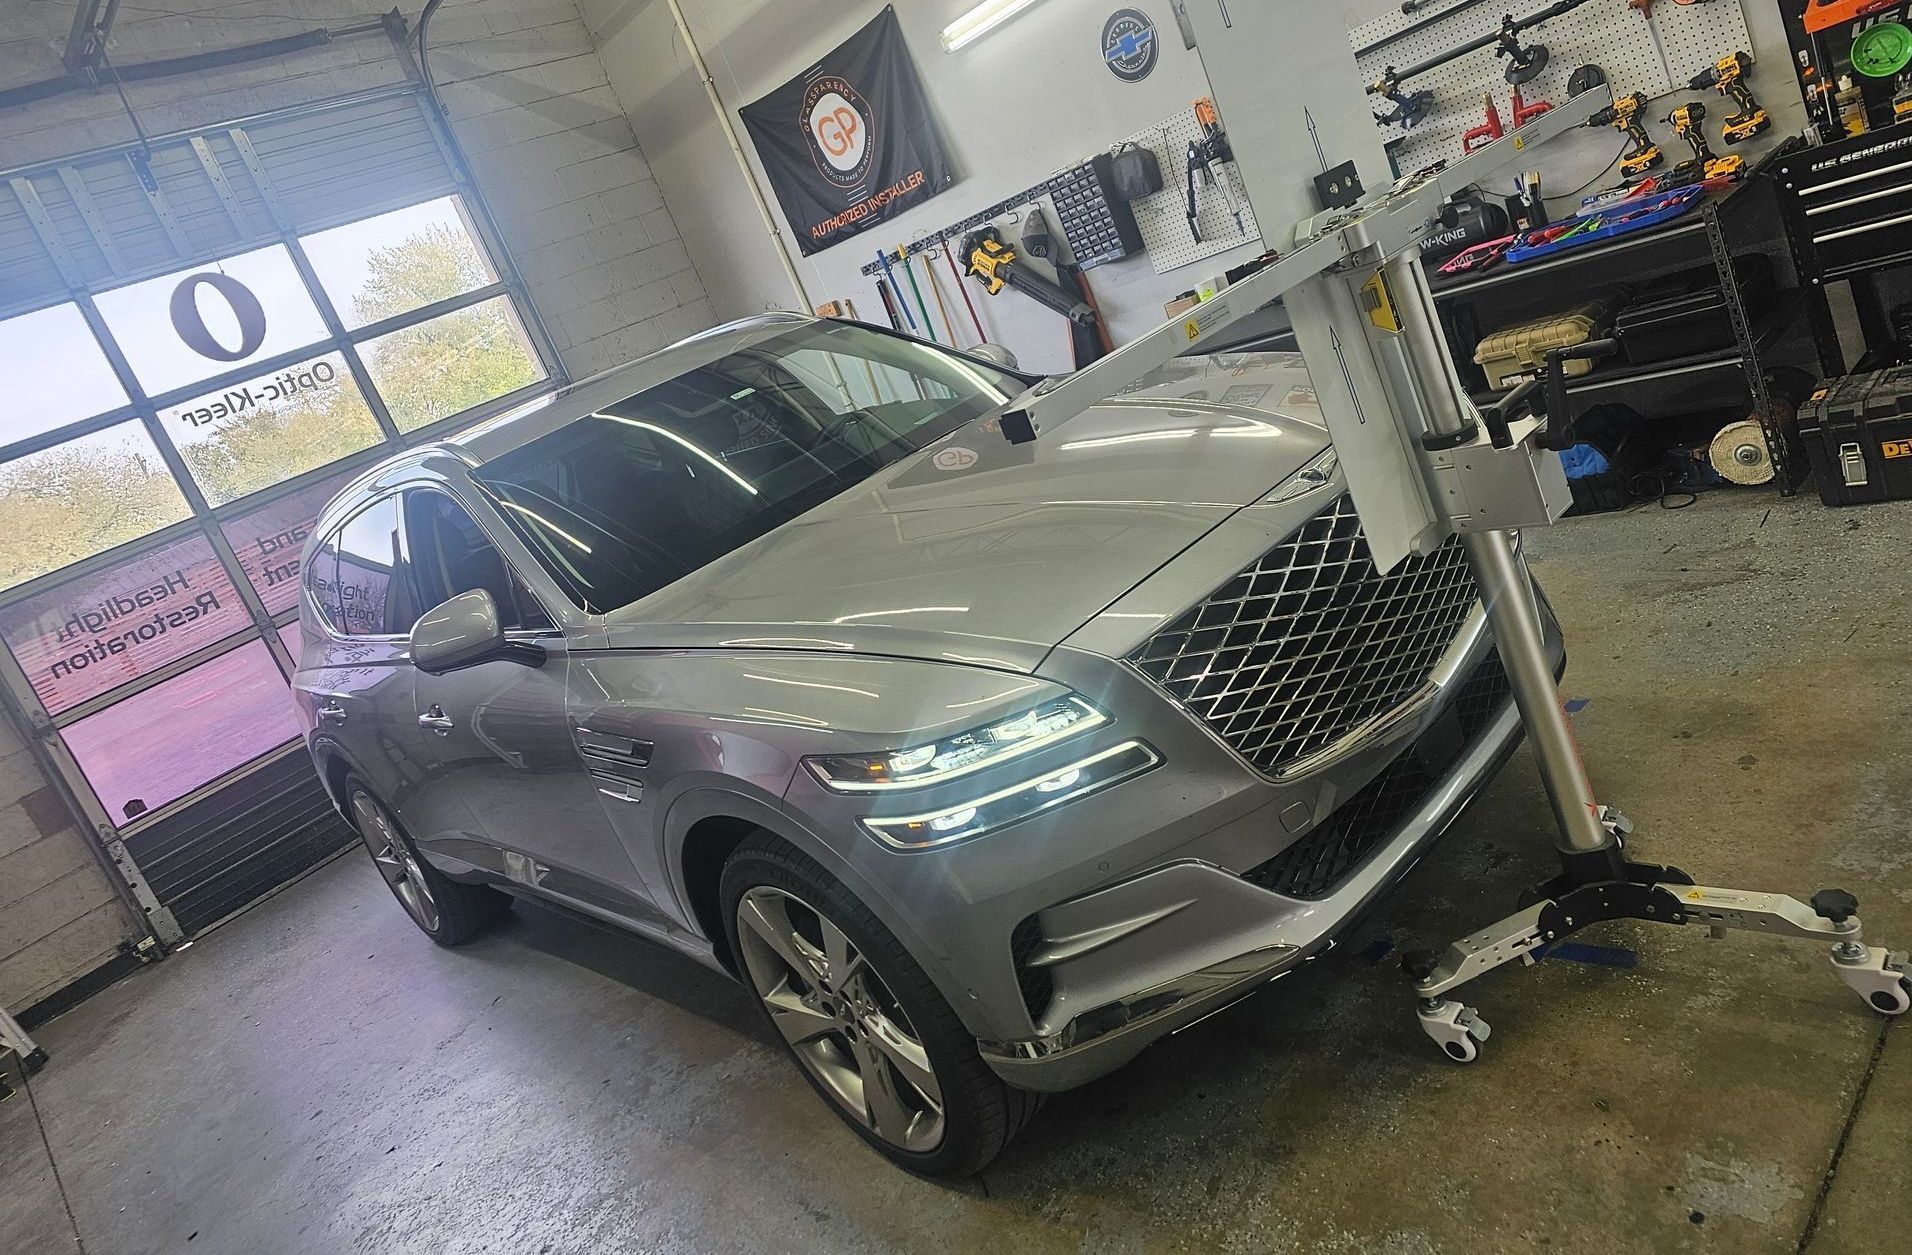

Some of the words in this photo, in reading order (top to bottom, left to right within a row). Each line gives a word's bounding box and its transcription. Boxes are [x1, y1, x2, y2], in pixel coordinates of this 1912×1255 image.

[802, 81, 857, 132] GLASSPARENCY
[817, 106, 857, 156] GP
[822, 162, 845, 181] PRODUCTS
[845, 172, 858, 181] MADE
[812, 203, 869, 239] AUTHORIZED
[867, 170, 926, 211] INSTALLER
[1420, 228, 1466, 249] W-KING
